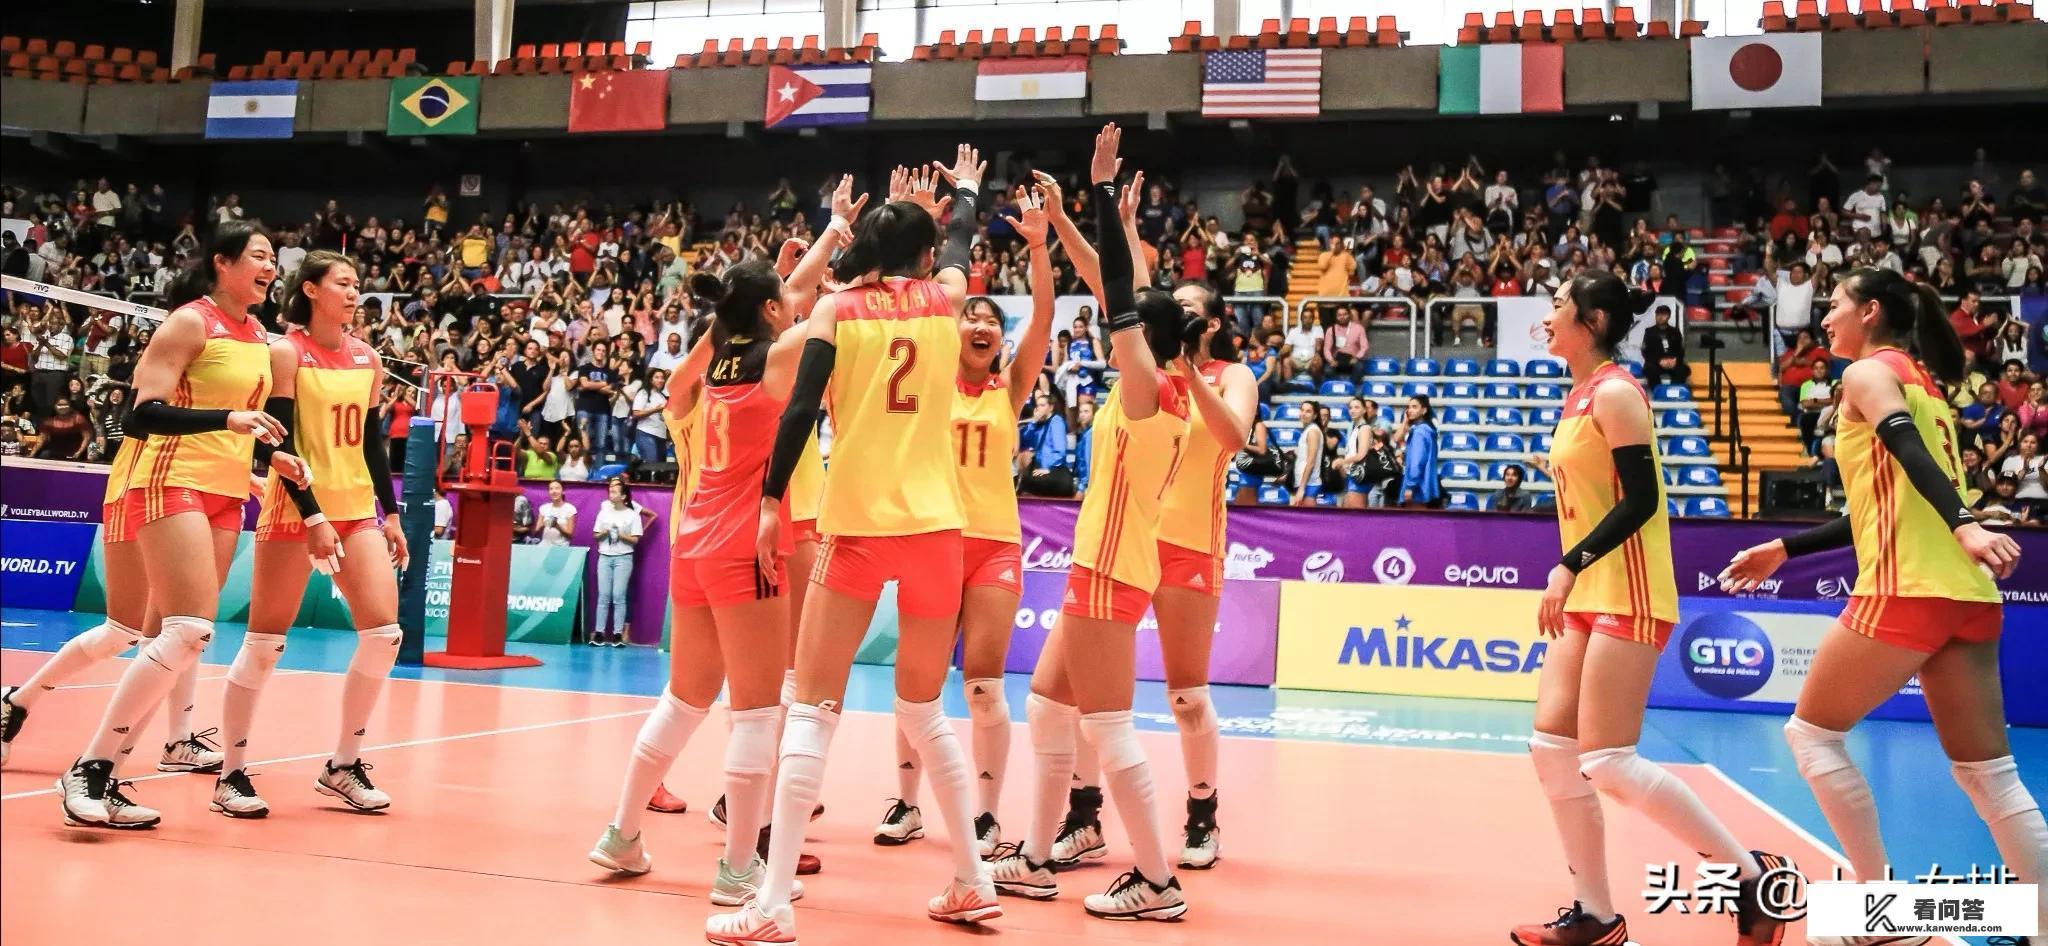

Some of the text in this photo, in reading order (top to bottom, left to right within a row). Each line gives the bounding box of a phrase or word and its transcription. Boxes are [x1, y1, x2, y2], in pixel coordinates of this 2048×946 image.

[887, 337, 918, 413] 2
[331, 403, 362, 448] 10
[957, 422, 988, 468] 11
[11, 507, 89, 519] VOLLEYBALLWORLD.TV
[1689, 637, 1764, 667] GTO
